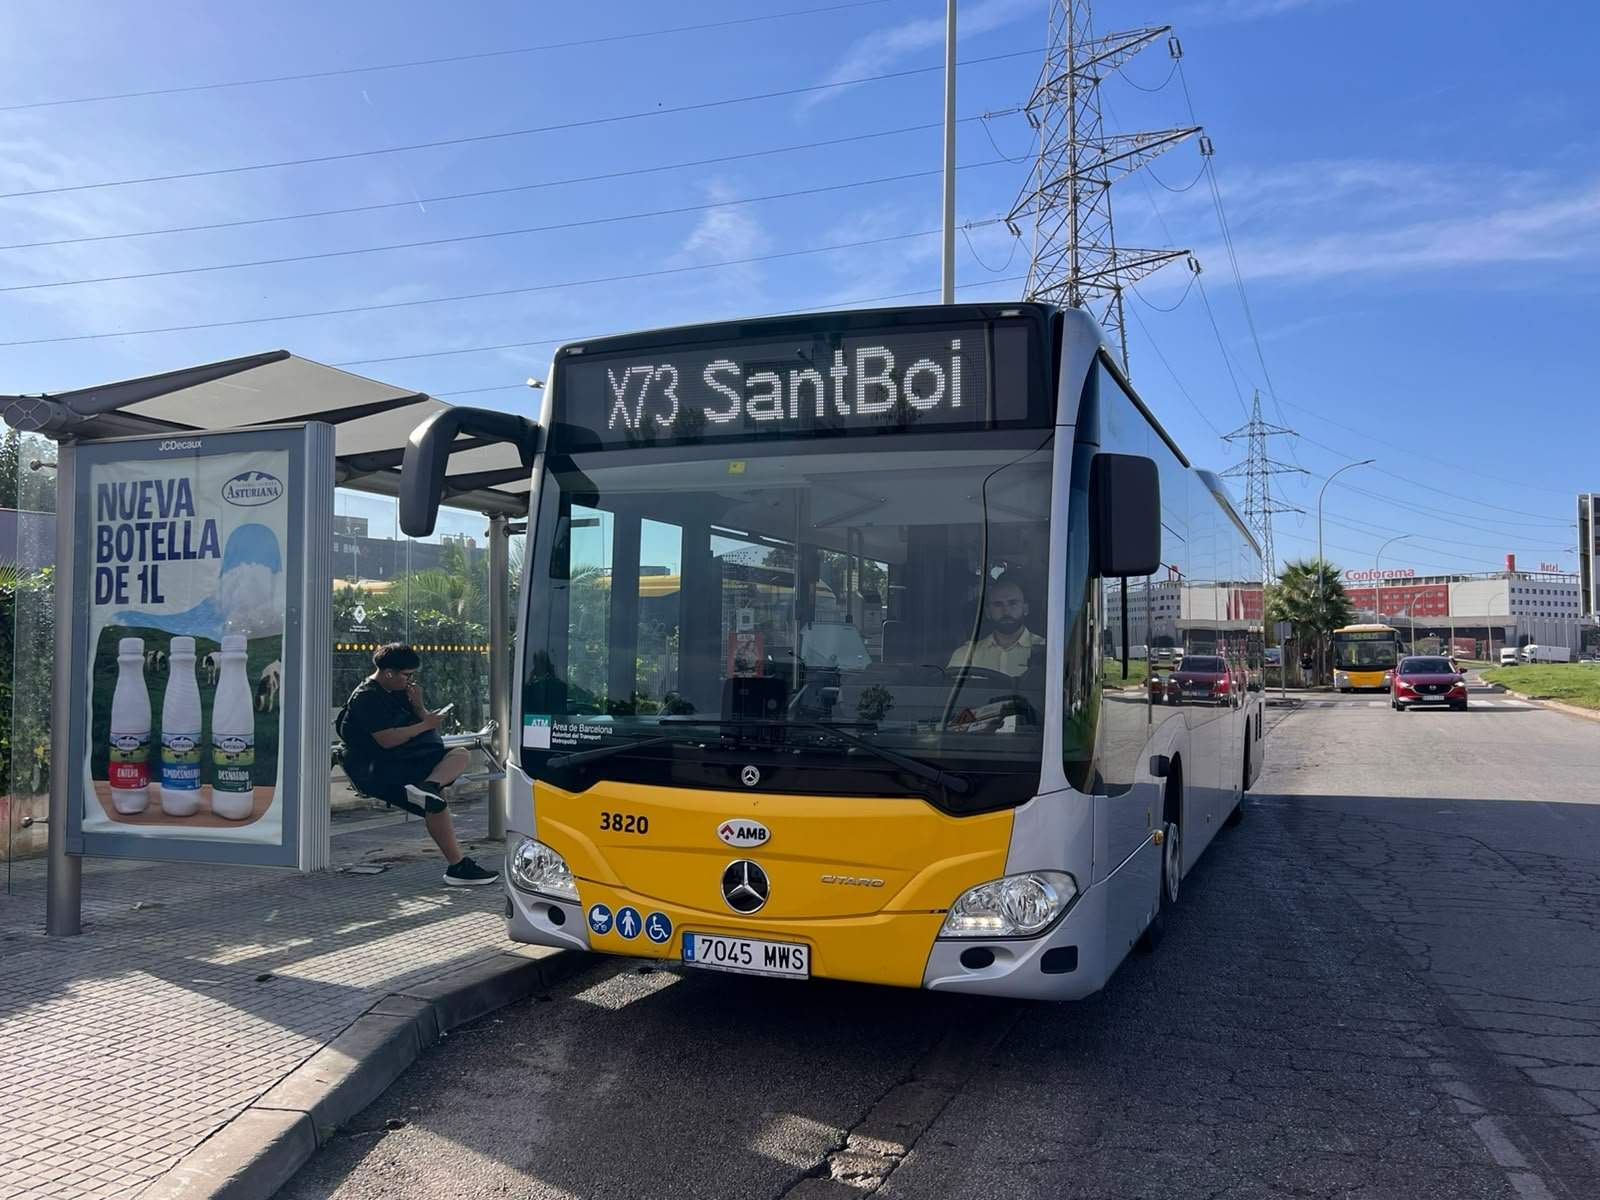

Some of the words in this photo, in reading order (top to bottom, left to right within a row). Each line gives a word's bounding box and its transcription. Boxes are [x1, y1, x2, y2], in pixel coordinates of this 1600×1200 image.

[607, 363, 679, 430] X73
[702, 338, 962, 424] SantBoi
[158, 440, 203, 451] JCDecaux
[98, 477, 195, 522] NUEVA
[96, 519, 221, 563] BOTELLA
[1345, 568, 1415, 581] Conforama
[95, 565, 128, 606] DE
[137, 565, 164, 604] 1L
[531, 719, 549, 728] ATM
[569, 723, 578, 732] de
[579, 723, 613, 735] Barcelona
[600, 812, 649, 835] 3820
[736, 827, 767, 841] AMB
[821, 875, 885, 888] CITARO
[701, 938, 753, 965] 7045
[764, 945, 804, 970] MWS
